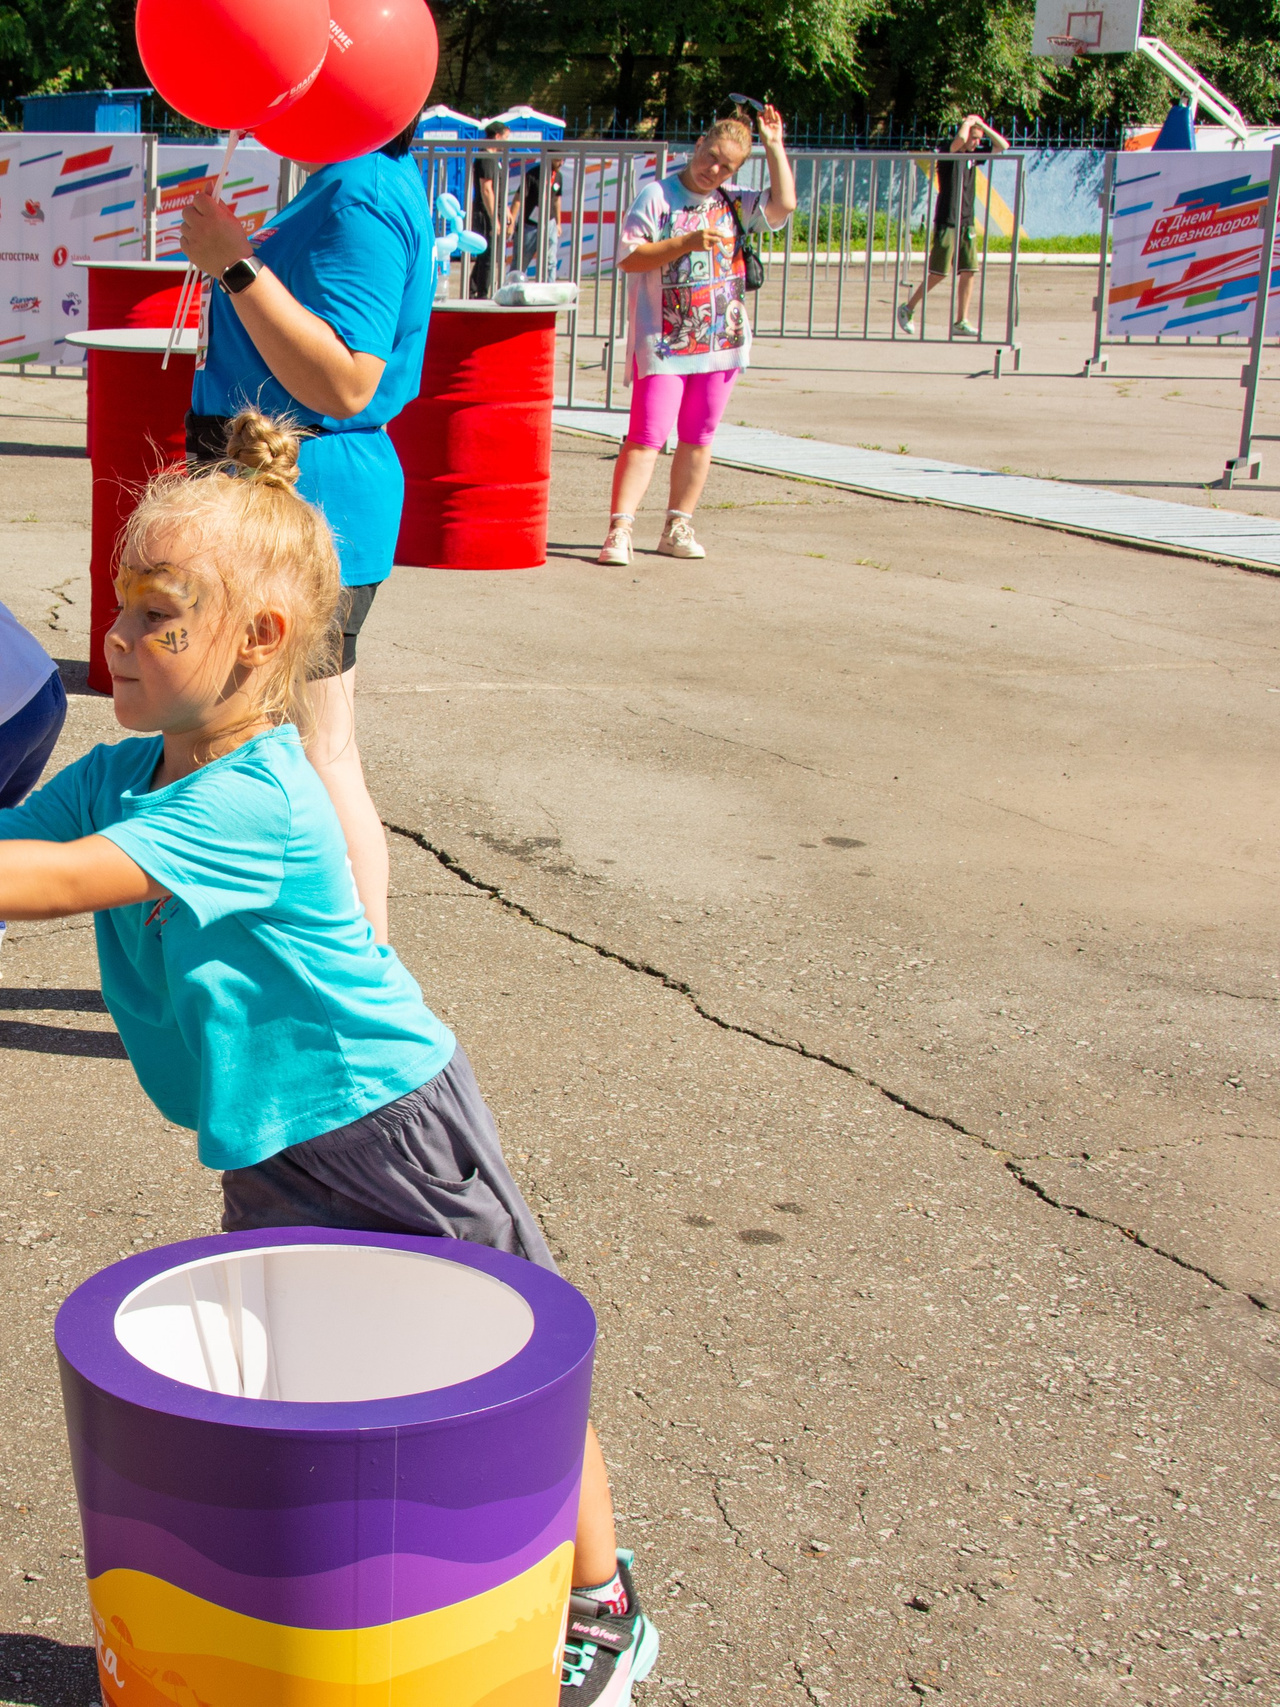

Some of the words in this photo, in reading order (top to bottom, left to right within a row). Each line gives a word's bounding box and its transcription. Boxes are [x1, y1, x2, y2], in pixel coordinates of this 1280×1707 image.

[1147, 214, 1259, 252] железнодорож
[1155, 218, 1166, 234] С
[1168, 209, 1213, 232] Днем
